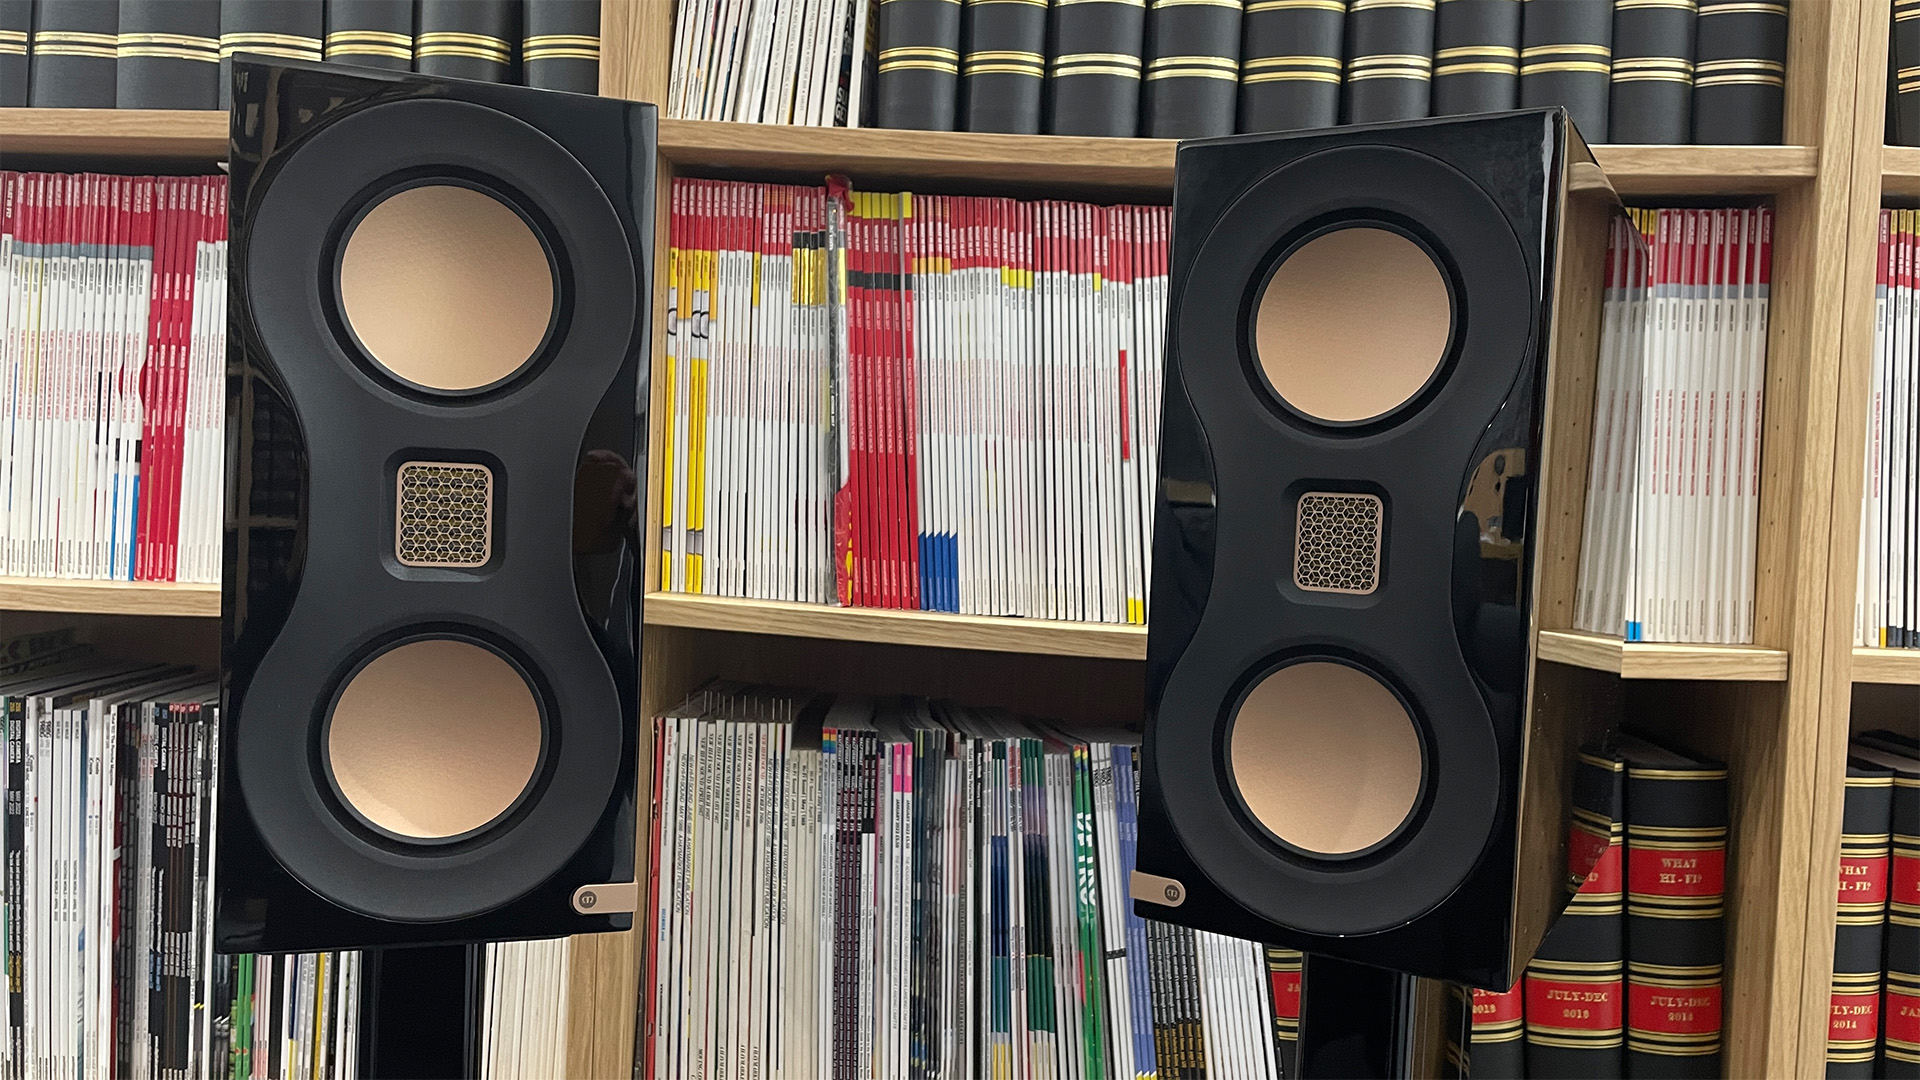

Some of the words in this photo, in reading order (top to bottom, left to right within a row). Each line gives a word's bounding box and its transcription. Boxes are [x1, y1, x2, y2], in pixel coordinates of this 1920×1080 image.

[1661, 858, 1698, 869] WHAT
[1547, 989, 1608, 1002] JULY-DEC
[1650, 996, 1711, 1008] JULY-DEC
[1833, 1020, 1857, 1029] 2014
